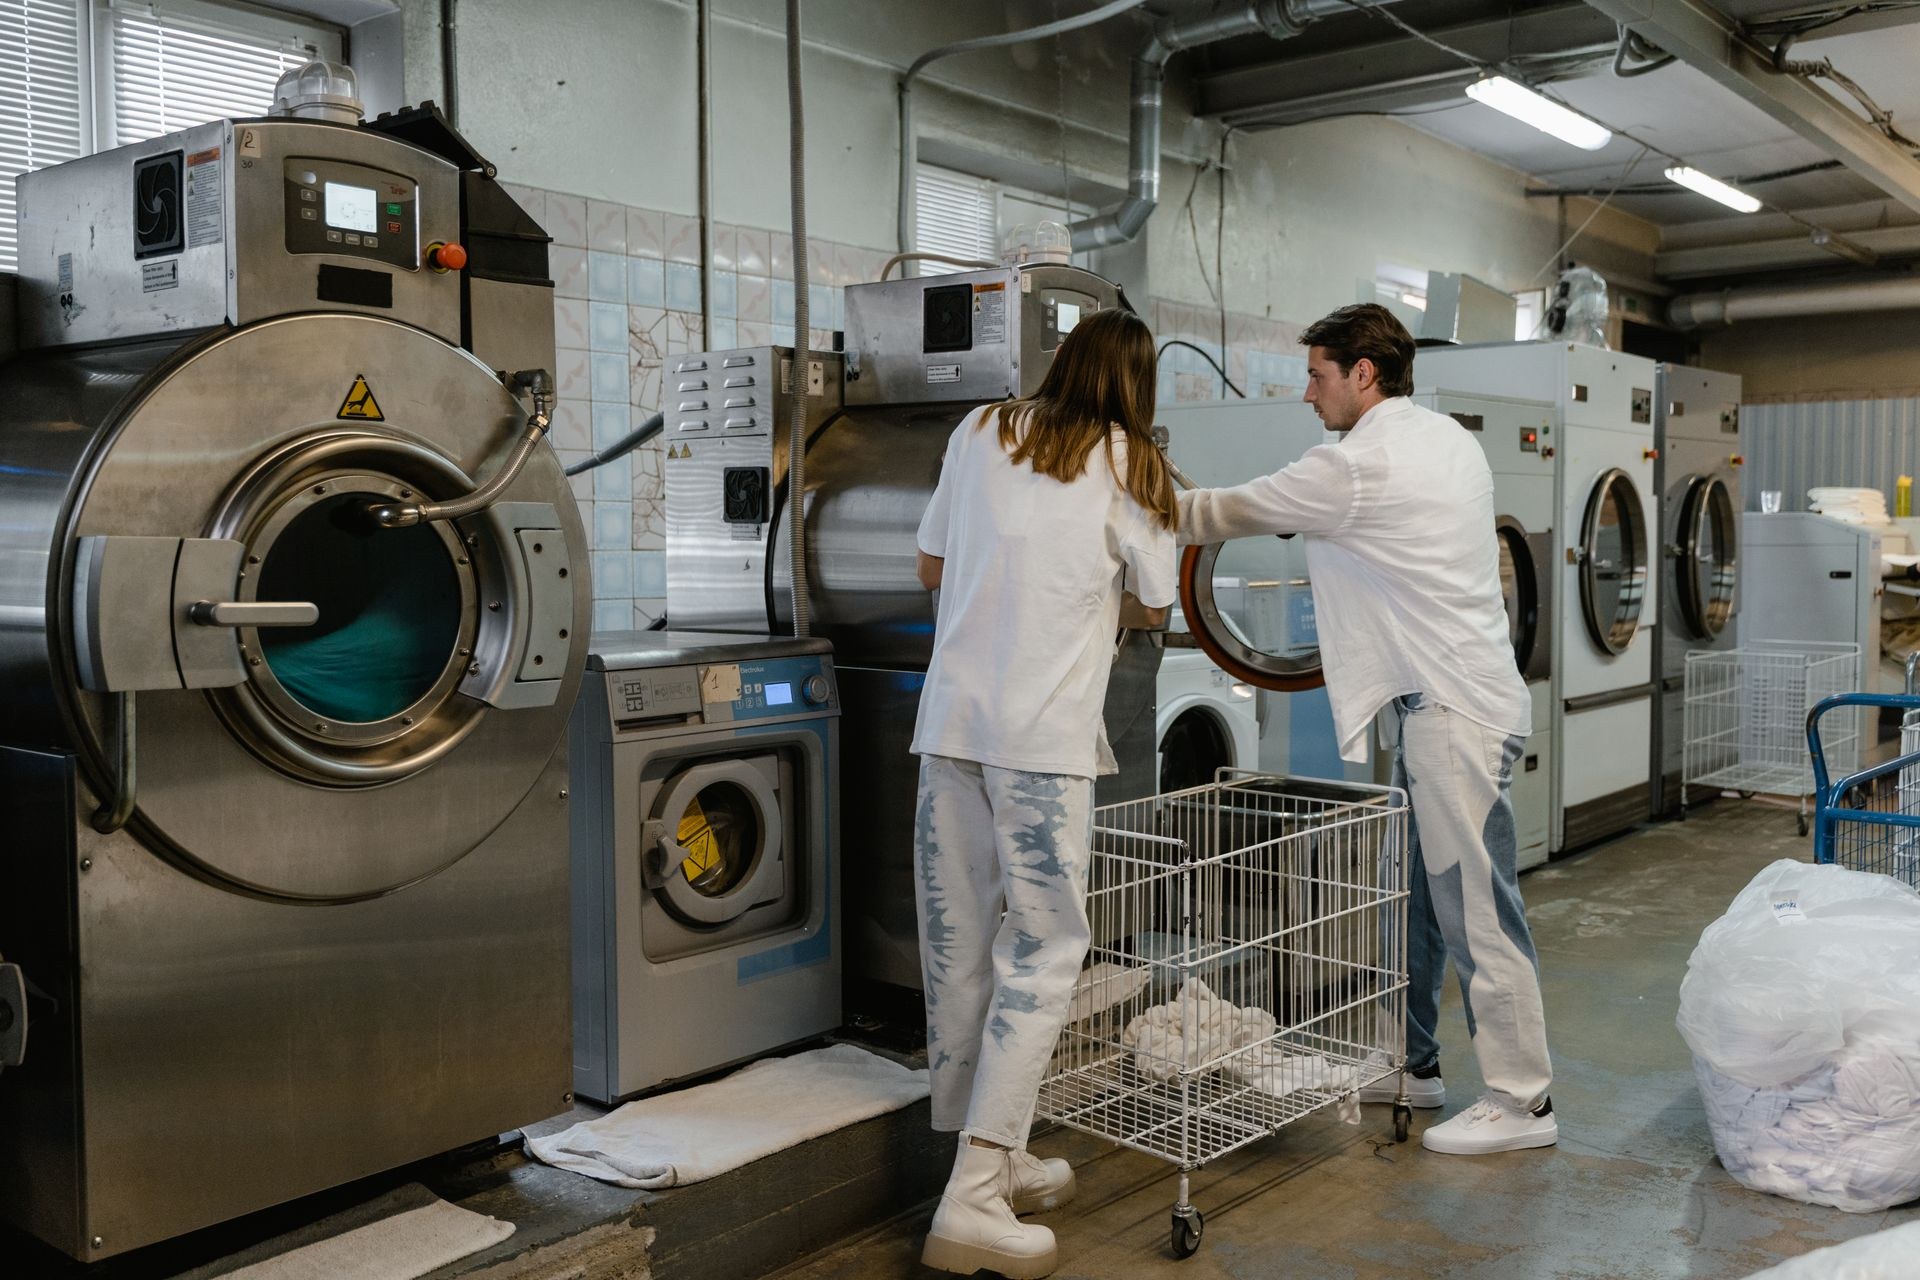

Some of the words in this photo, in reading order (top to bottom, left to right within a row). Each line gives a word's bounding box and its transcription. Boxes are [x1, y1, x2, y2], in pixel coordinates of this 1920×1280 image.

[244, 132, 255, 148] 2
[241, 159, 253, 169] 30
[740, 666, 764, 674] Electrolux
[711, 674, 718, 690] 1
